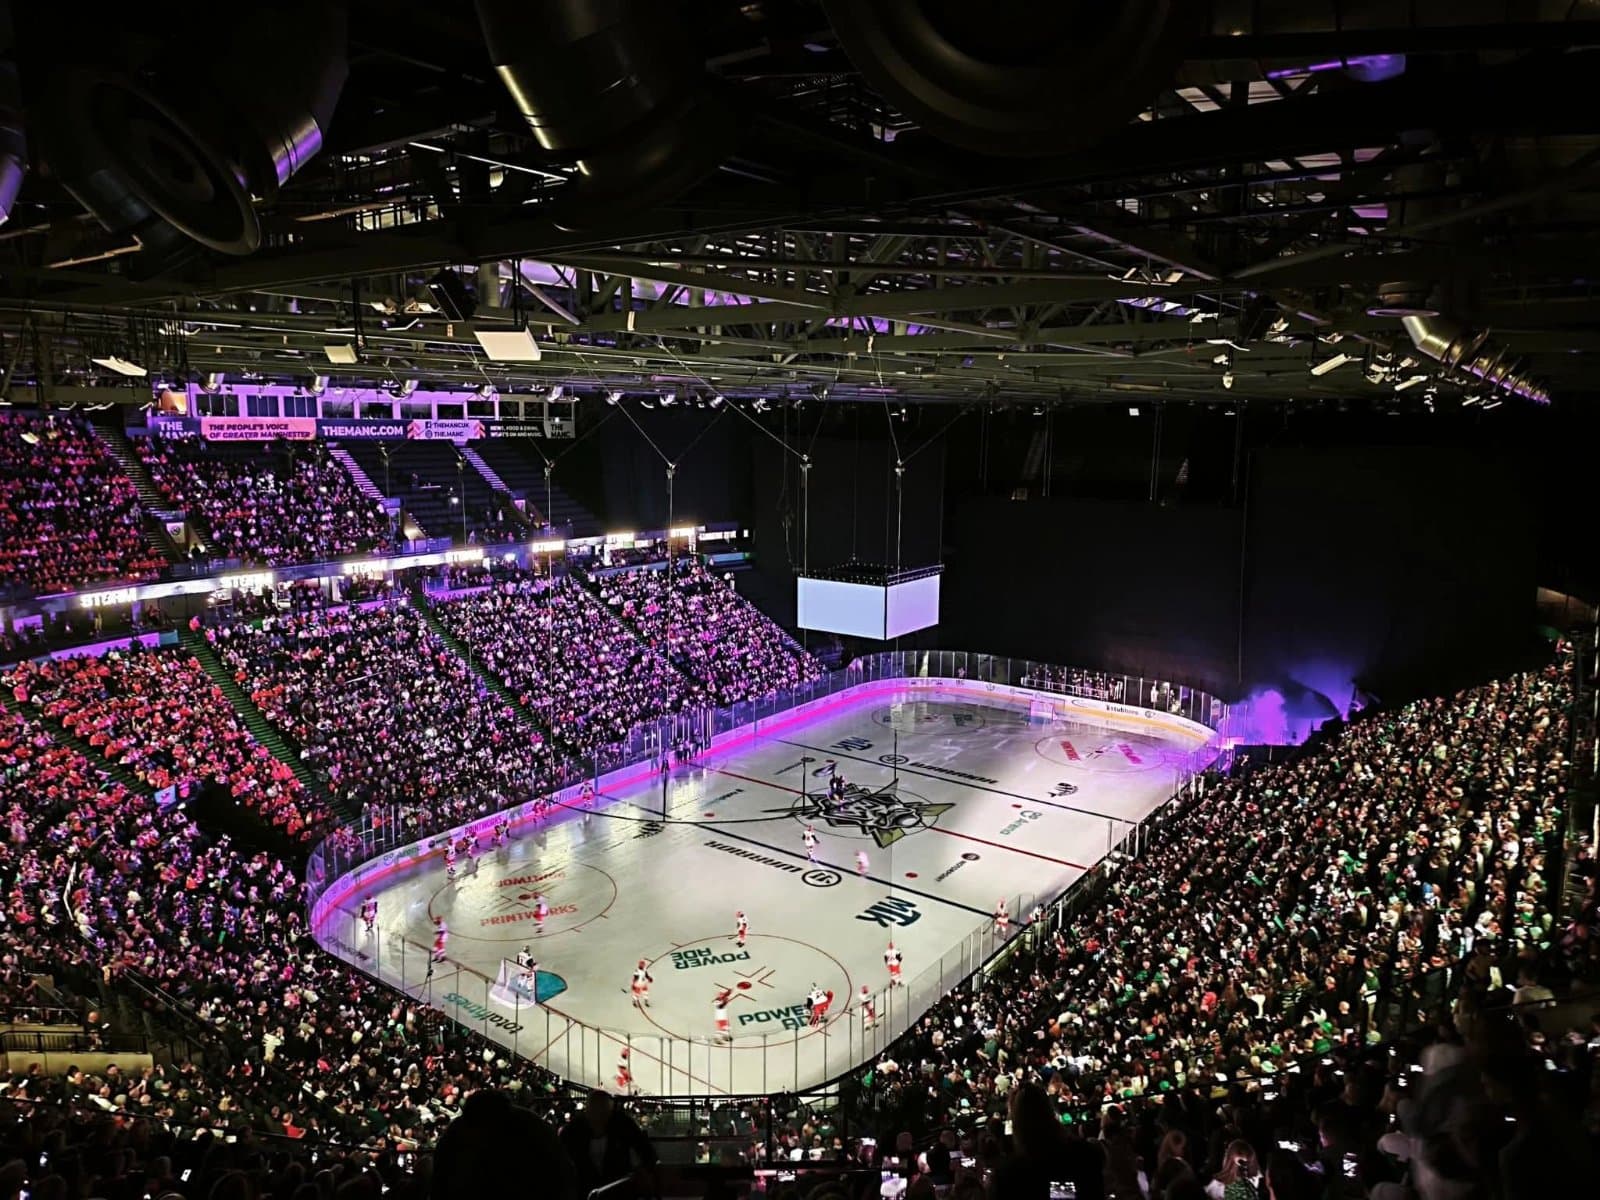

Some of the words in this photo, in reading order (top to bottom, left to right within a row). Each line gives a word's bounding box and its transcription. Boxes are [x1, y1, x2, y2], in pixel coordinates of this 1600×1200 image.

[158, 421, 184, 431] THE
[226, 423, 264, 431] PEOPLE'S
[321, 425, 404, 437] THEMANC.COM
[550, 423, 564, 431] THE
[222, 431, 258, 439] GREATER
[673, 950, 750, 970] POWER
[738, 1004, 806, 1026] POWE
